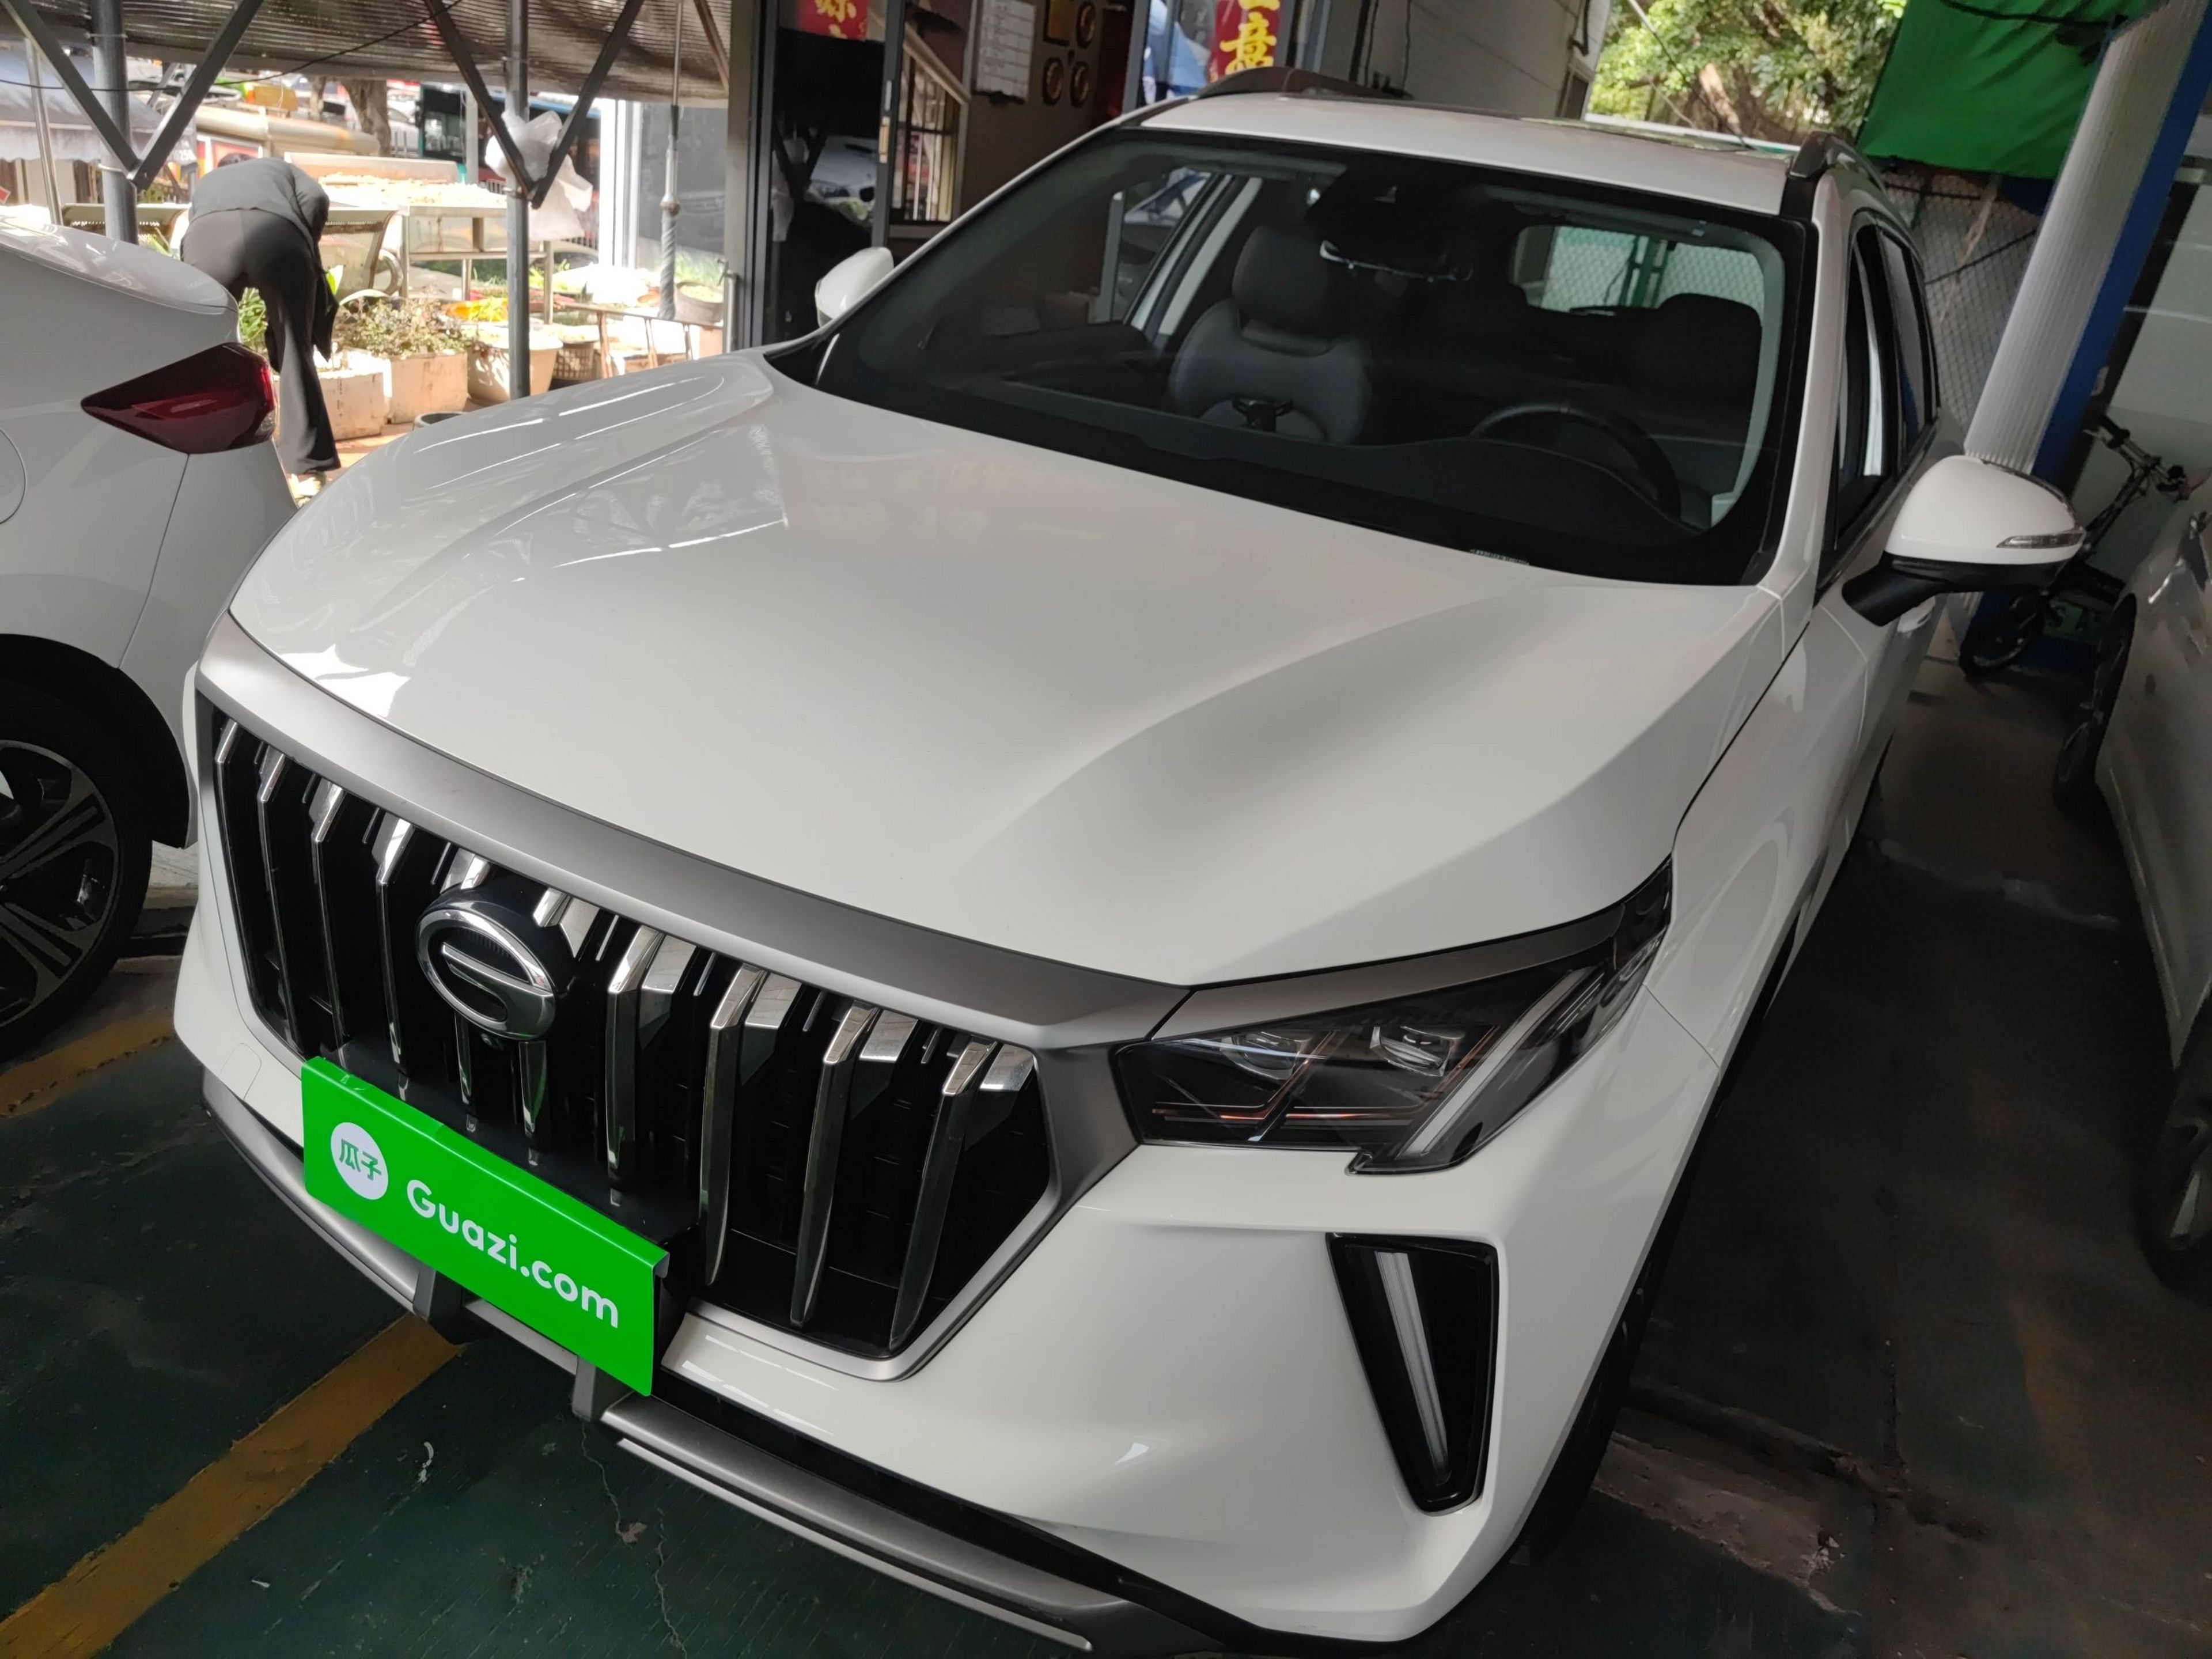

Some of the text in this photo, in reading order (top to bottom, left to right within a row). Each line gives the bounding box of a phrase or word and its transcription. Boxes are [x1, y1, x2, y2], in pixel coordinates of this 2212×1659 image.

[1219, 0, 1280, 75] 意
[339, 1138, 382, 1181] 瓜子
[406, 1179, 619, 1328] Guazi.com
